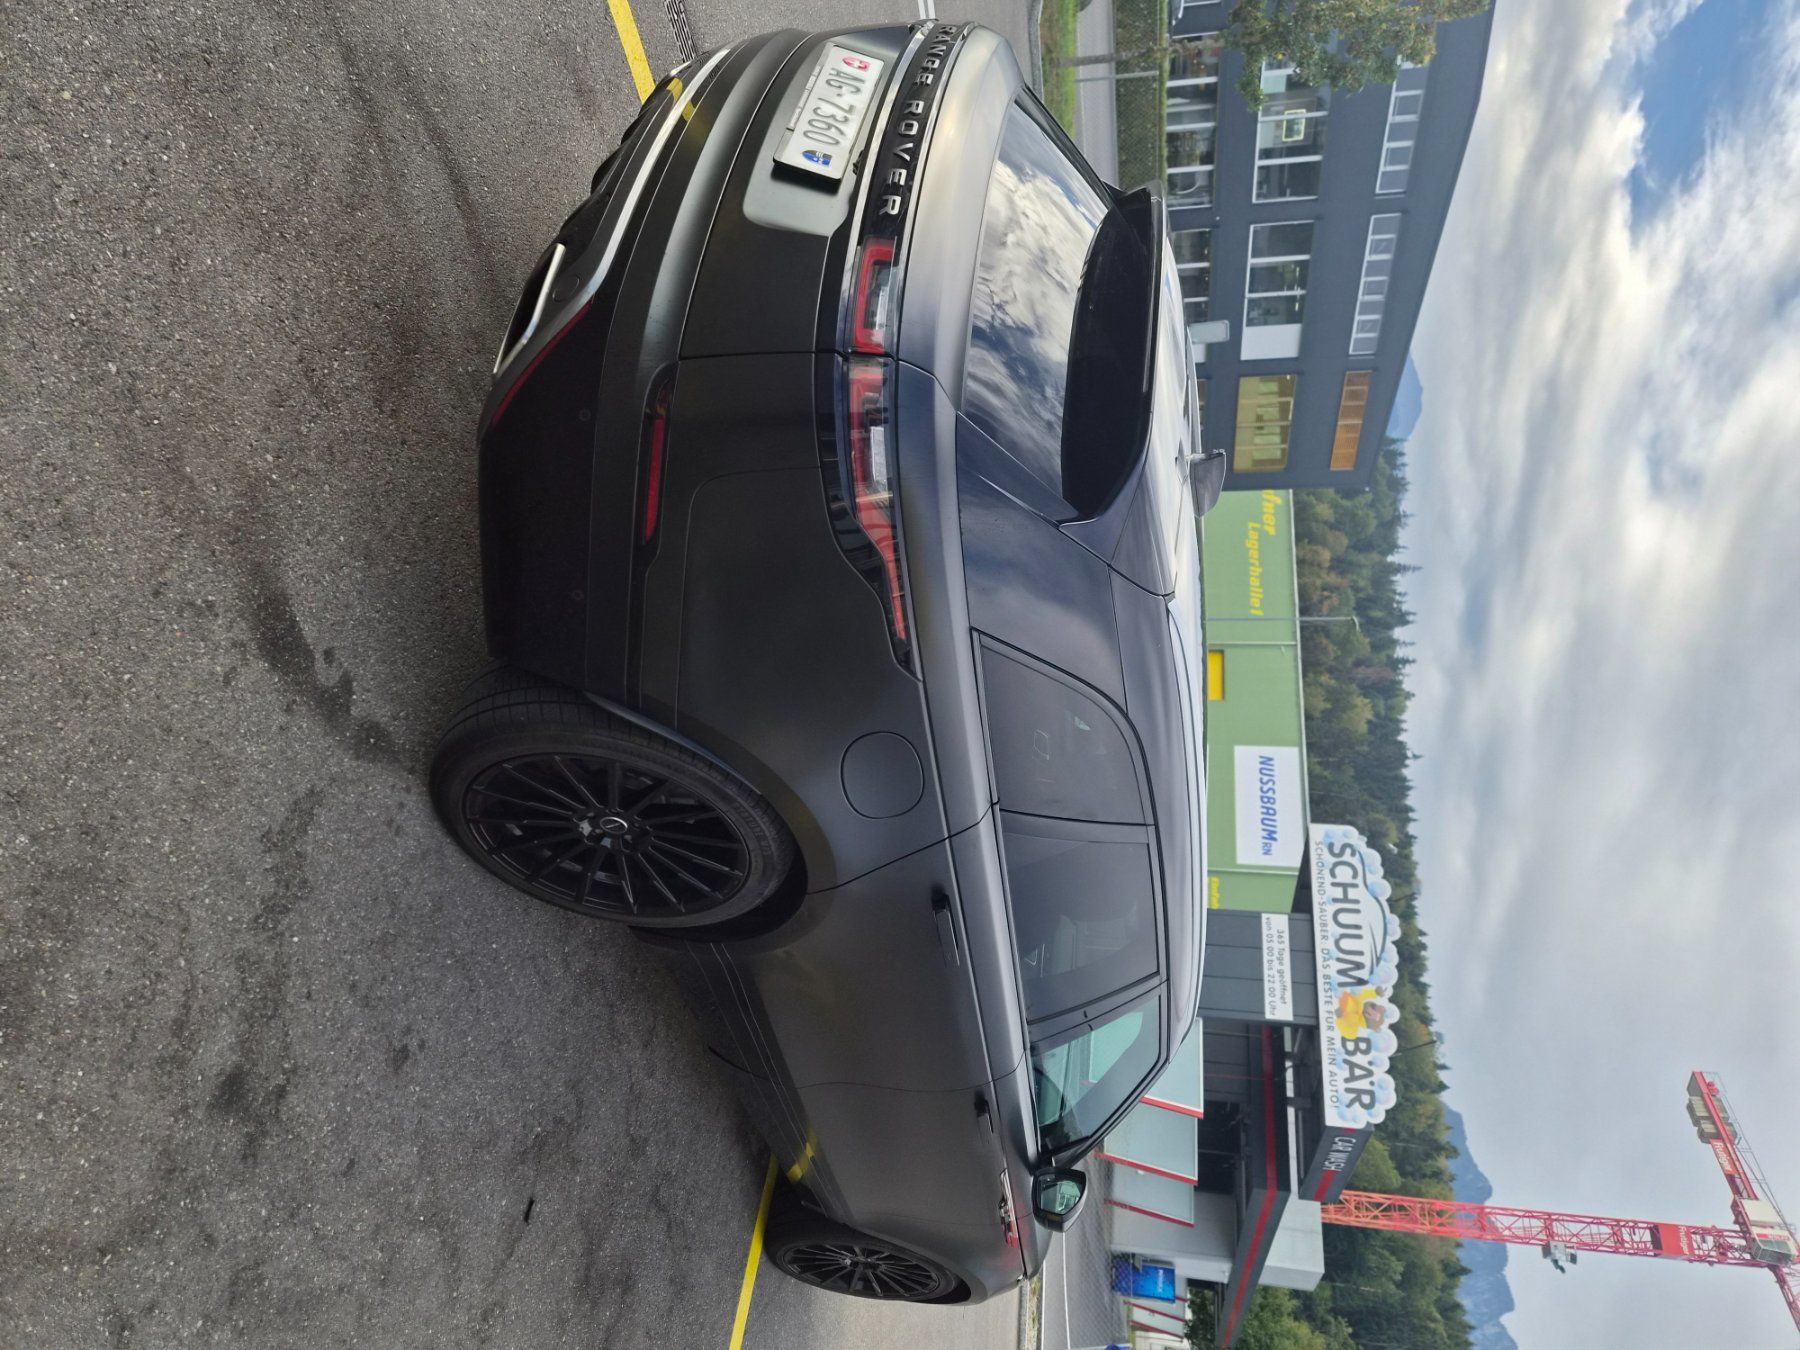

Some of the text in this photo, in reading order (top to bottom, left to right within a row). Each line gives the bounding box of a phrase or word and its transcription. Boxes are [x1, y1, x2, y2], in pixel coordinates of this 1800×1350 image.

[825, 68, 866, 95] AG
[802, 98, 854, 146] 7360
[878, 25, 957, 216] RANGE ROVER
[1258, 755, 1278, 856] NUSSBAUM RN
[1276, 929, 1285, 945] 365
[1267, 960, 1275, 972] bis
[1276, 948, 1286, 966] Tage
[1320, 948, 1331, 970] DAS
[1322, 974, 1334, 1006] BESTE
[1327, 841, 1376, 1110] SCHUUM BÄR
[1268, 1000, 1276, 1016] Uhr
[1326, 1036, 1337, 1066] MEIN
[1328, 1070, 1340, 1109] AUTO!
[1322, 1136, 1356, 1172] CAR WASH
[1713, 1142, 1733, 1171] Frutiger
[1678, 1226, 1690, 1255] Frutiger
